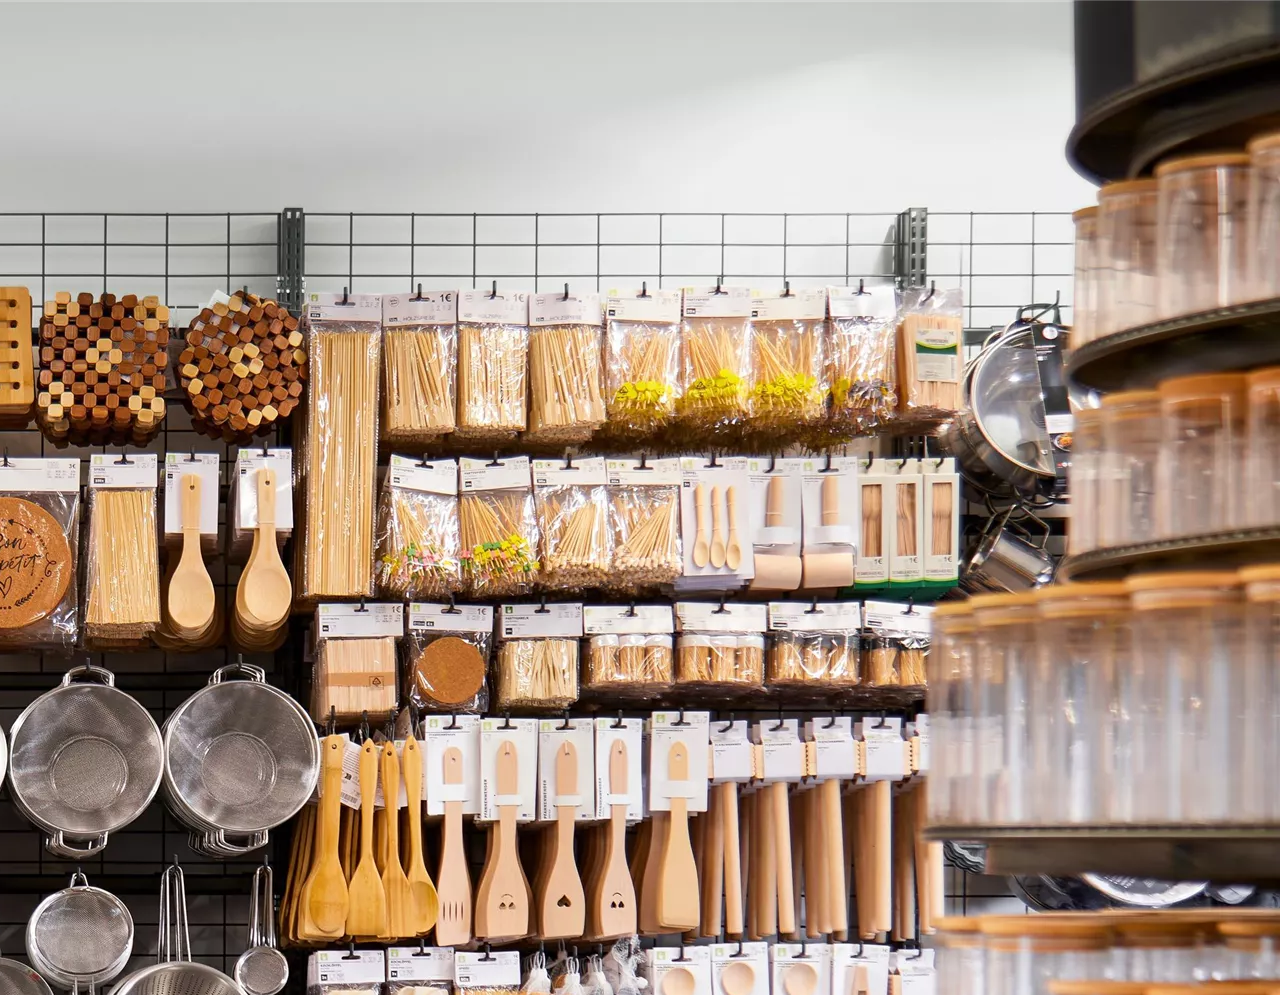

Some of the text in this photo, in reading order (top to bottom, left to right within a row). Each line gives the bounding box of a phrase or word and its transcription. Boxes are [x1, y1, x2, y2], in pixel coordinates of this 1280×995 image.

[439, 293, 451, 302] 1€
[513, 293, 525, 302] 1€
[477, 608, 487, 616] 1€
